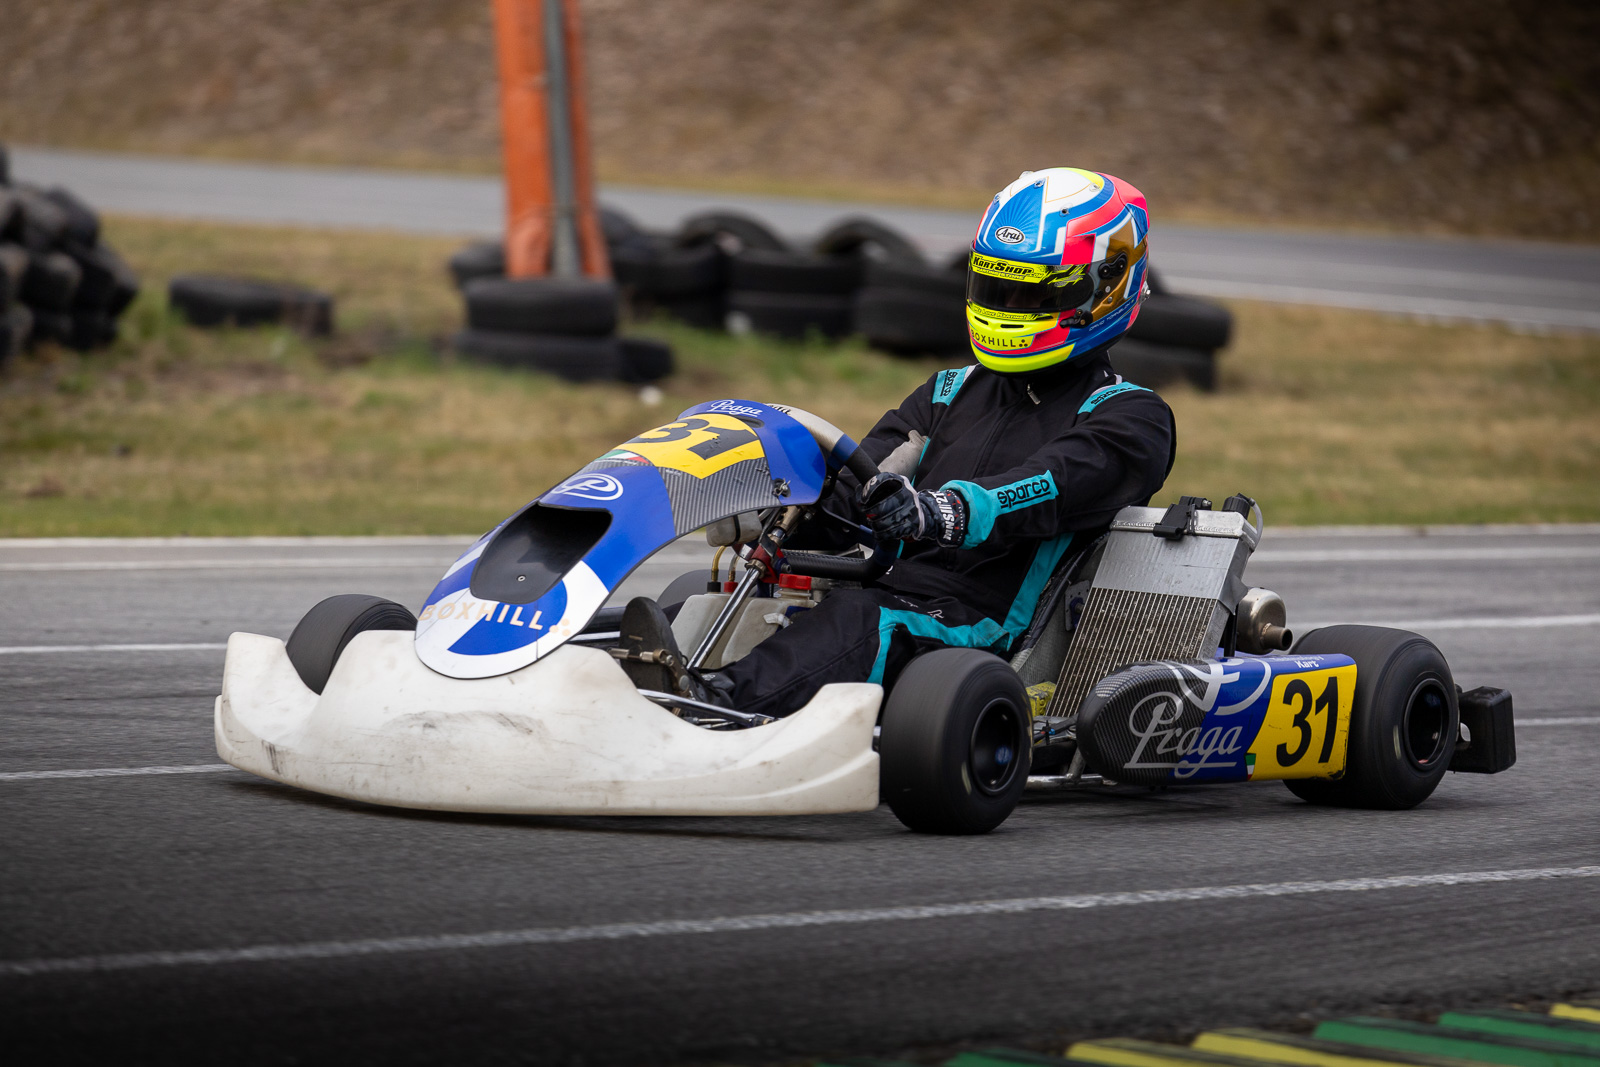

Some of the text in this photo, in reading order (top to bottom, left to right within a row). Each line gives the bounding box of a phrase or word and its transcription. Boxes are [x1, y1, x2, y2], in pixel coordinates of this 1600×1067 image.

[998, 228, 1021, 241] Arai
[971, 329, 1016, 348] BOXHILL
[706, 399, 763, 418] Praga
[624, 418, 759, 460] 31
[997, 479, 1051, 509] sparco
[418, 601, 543, 631] BOXHILL
[1294, 660, 1320, 669] Kart
[1124, 691, 1243, 778] Praga
[1276, 676, 1339, 768] 31
